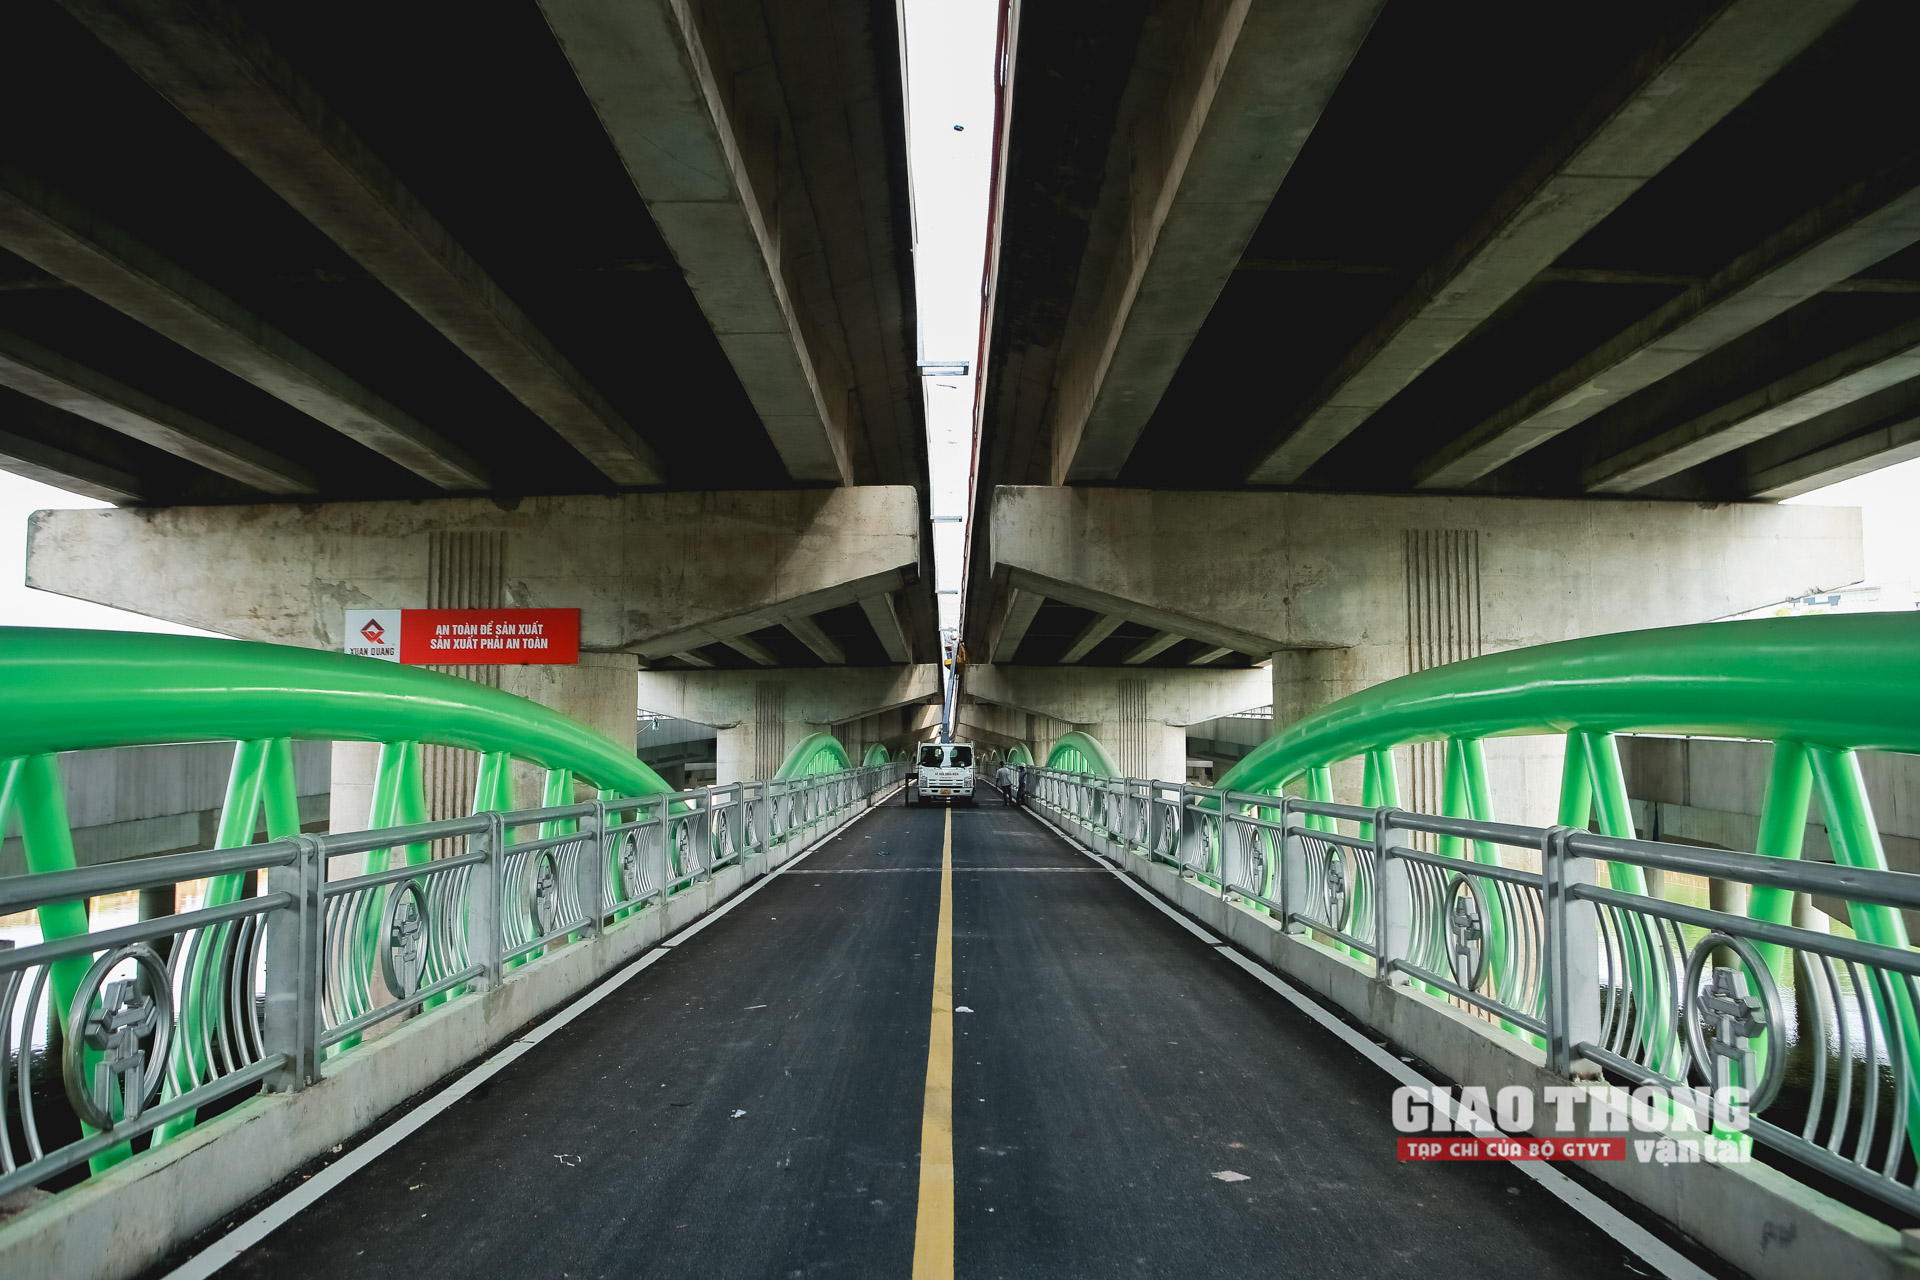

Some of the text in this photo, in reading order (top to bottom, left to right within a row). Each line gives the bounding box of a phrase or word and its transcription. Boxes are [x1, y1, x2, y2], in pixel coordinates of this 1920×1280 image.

[436, 620, 544, 635] AN TOÀN ĐỂ SẢN XUẤT
[430, 635, 548, 649] SẢN XUẤT PHẢI AN TOÀN
[371, 647, 394, 656] QUANG
